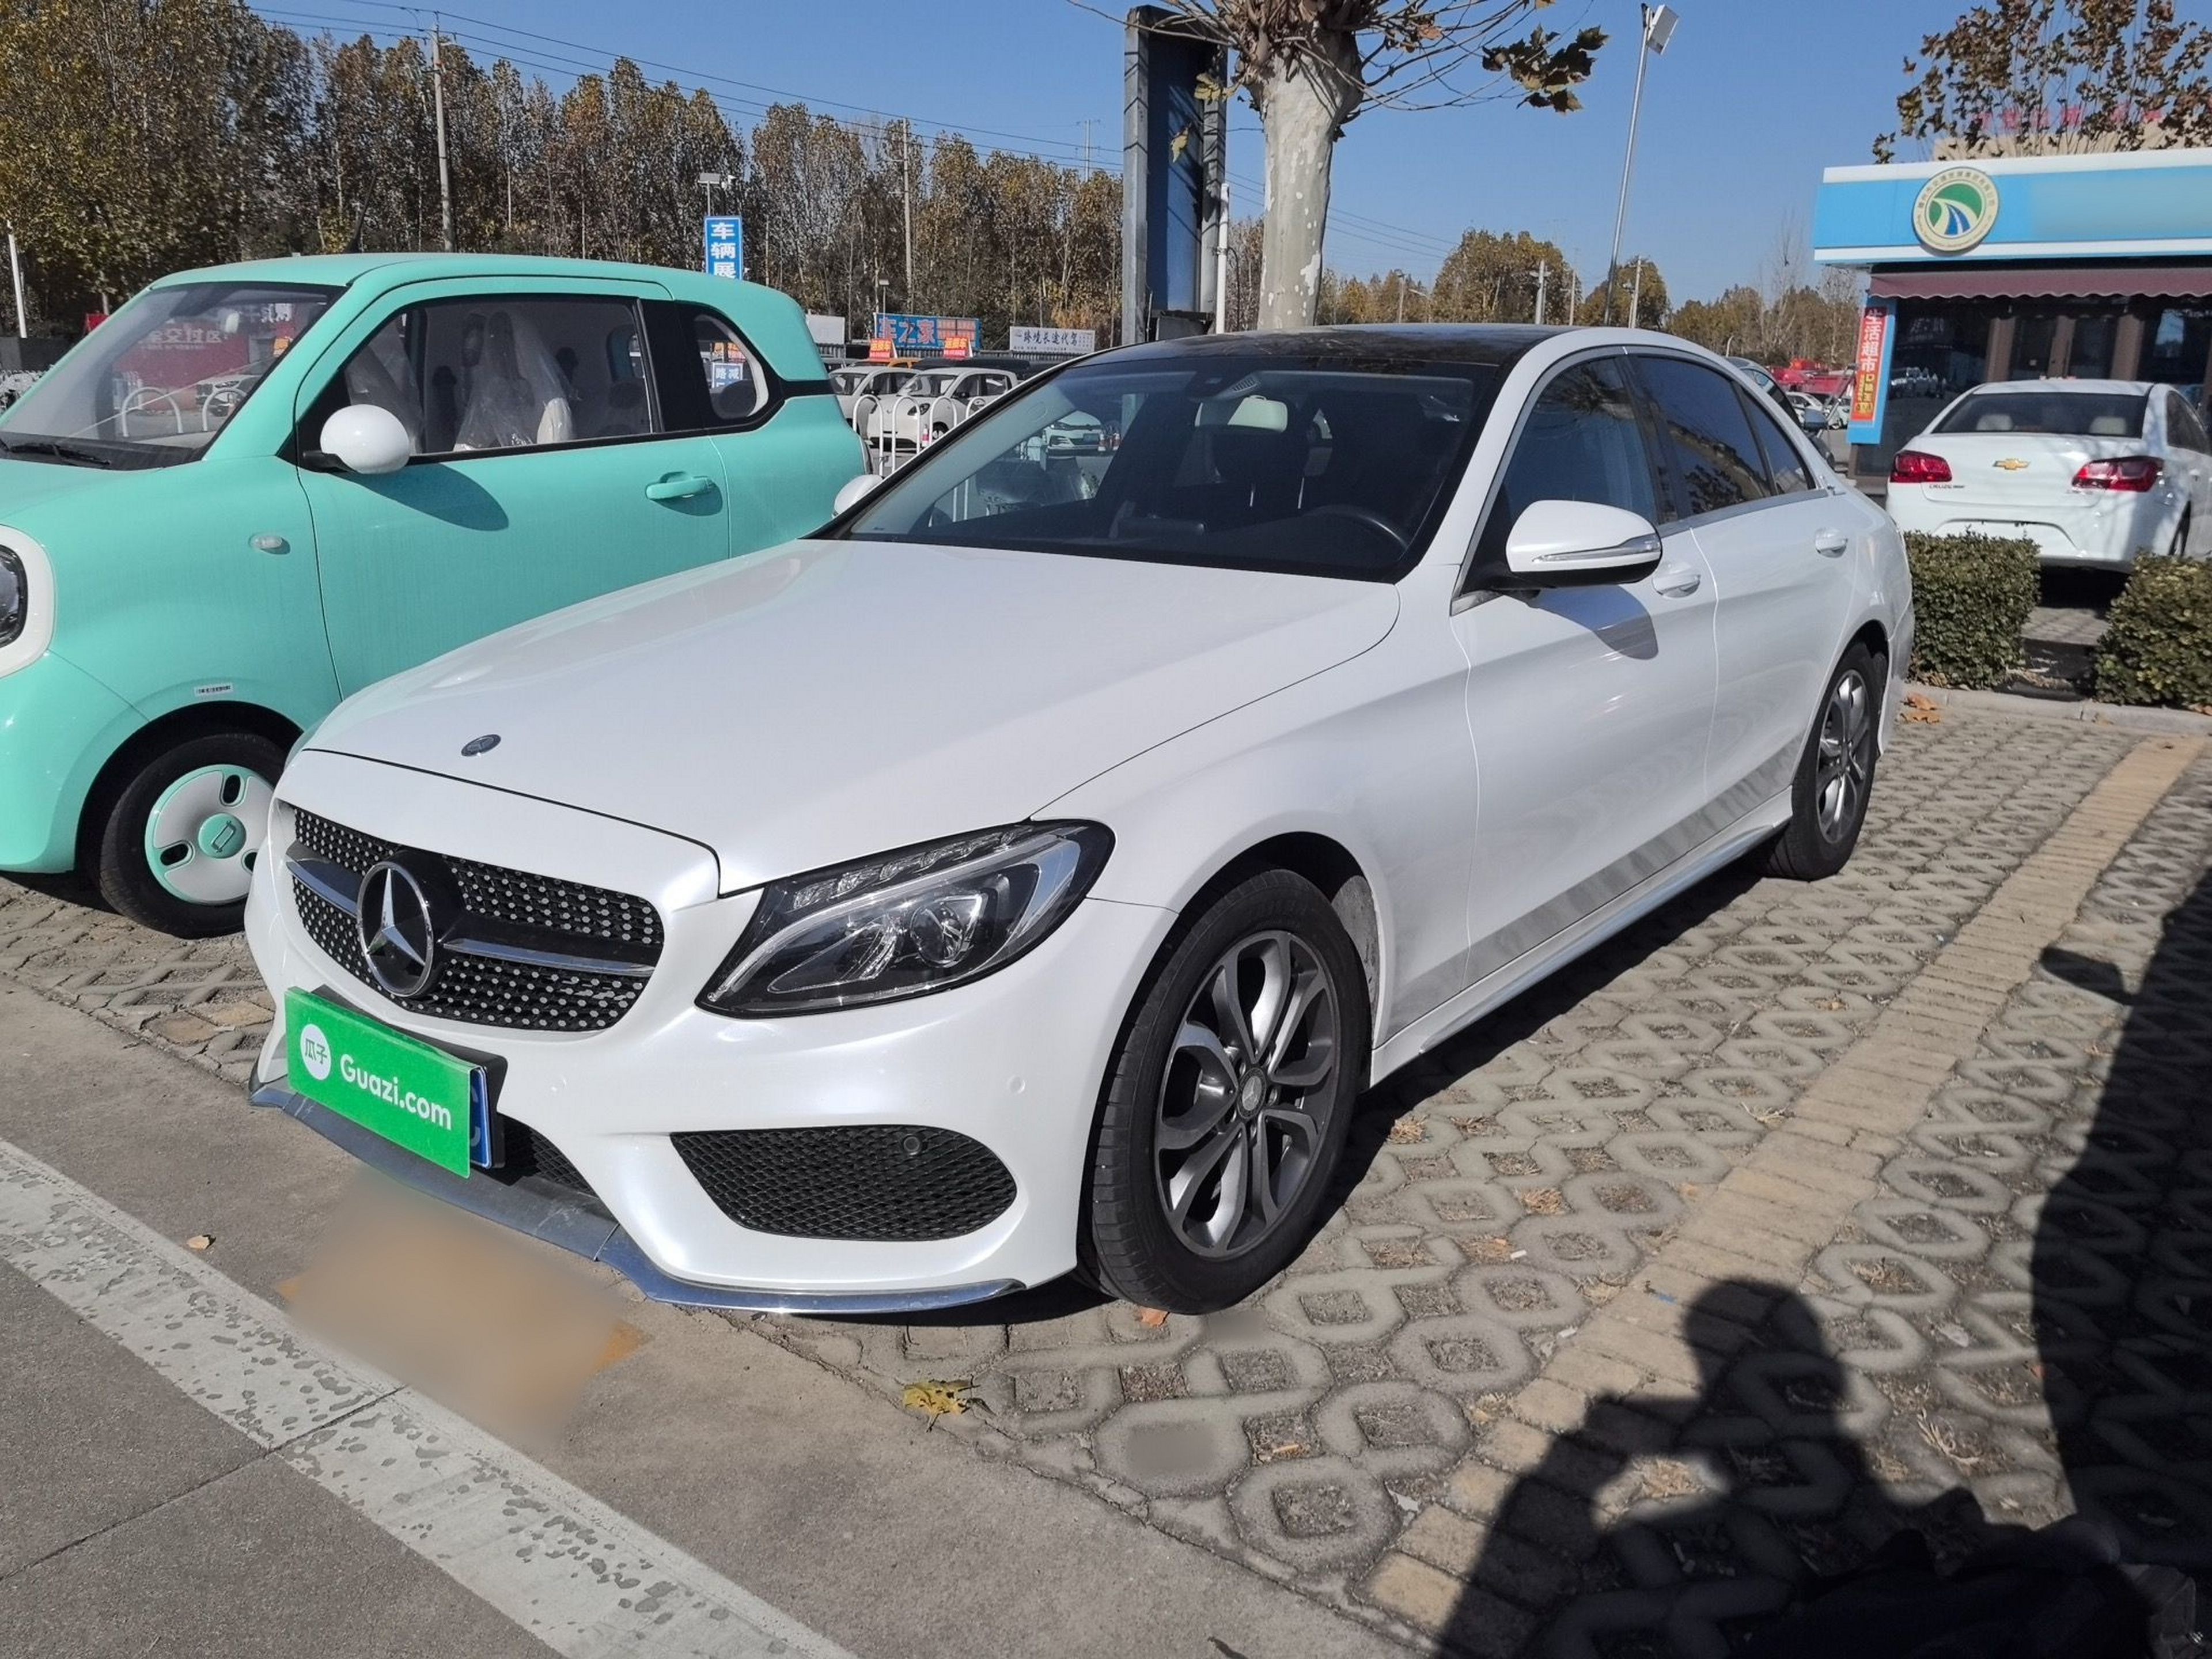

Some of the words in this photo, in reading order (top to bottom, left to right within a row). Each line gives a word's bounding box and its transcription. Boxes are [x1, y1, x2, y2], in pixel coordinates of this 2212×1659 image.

[1860, 309, 1882, 372] 生活超市
[305, 1037, 327, 1065] 瓜子
[340, 1054, 452, 1130] Guazi.com
